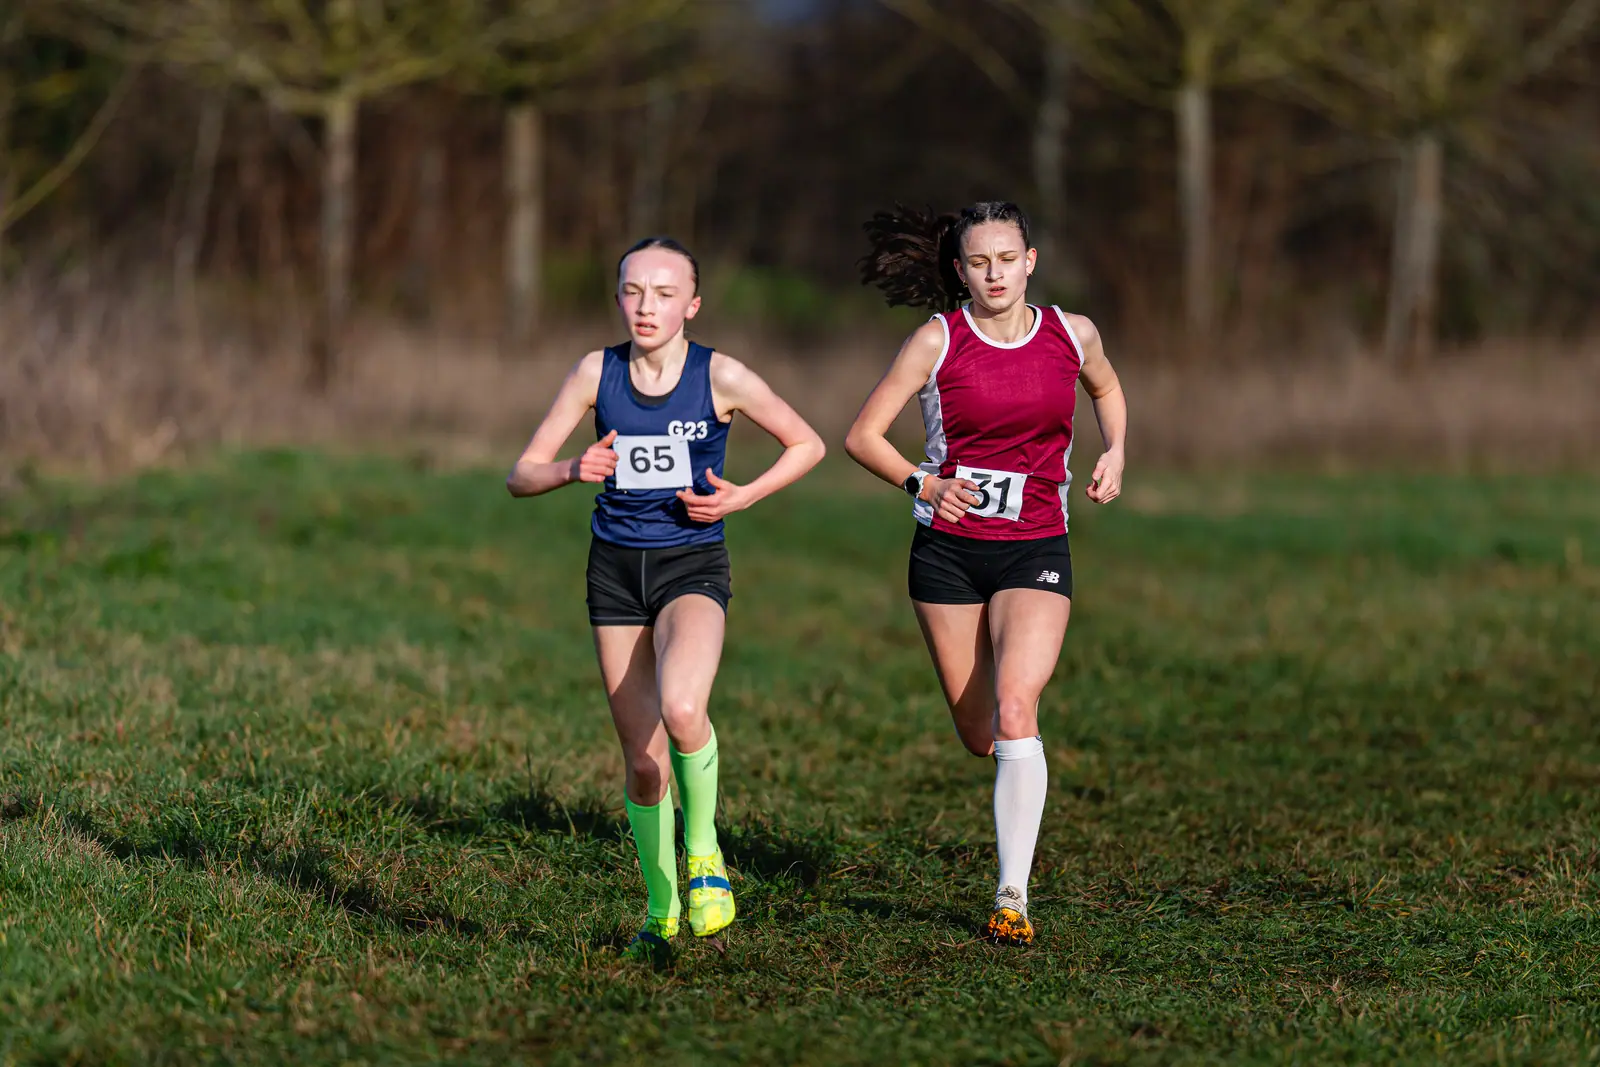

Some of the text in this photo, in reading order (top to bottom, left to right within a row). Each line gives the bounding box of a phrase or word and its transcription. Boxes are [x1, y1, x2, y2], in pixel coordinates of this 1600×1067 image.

[668, 420, 708, 441] G23
[630, 445, 675, 473] 65
[970, 472, 1011, 513] 31
